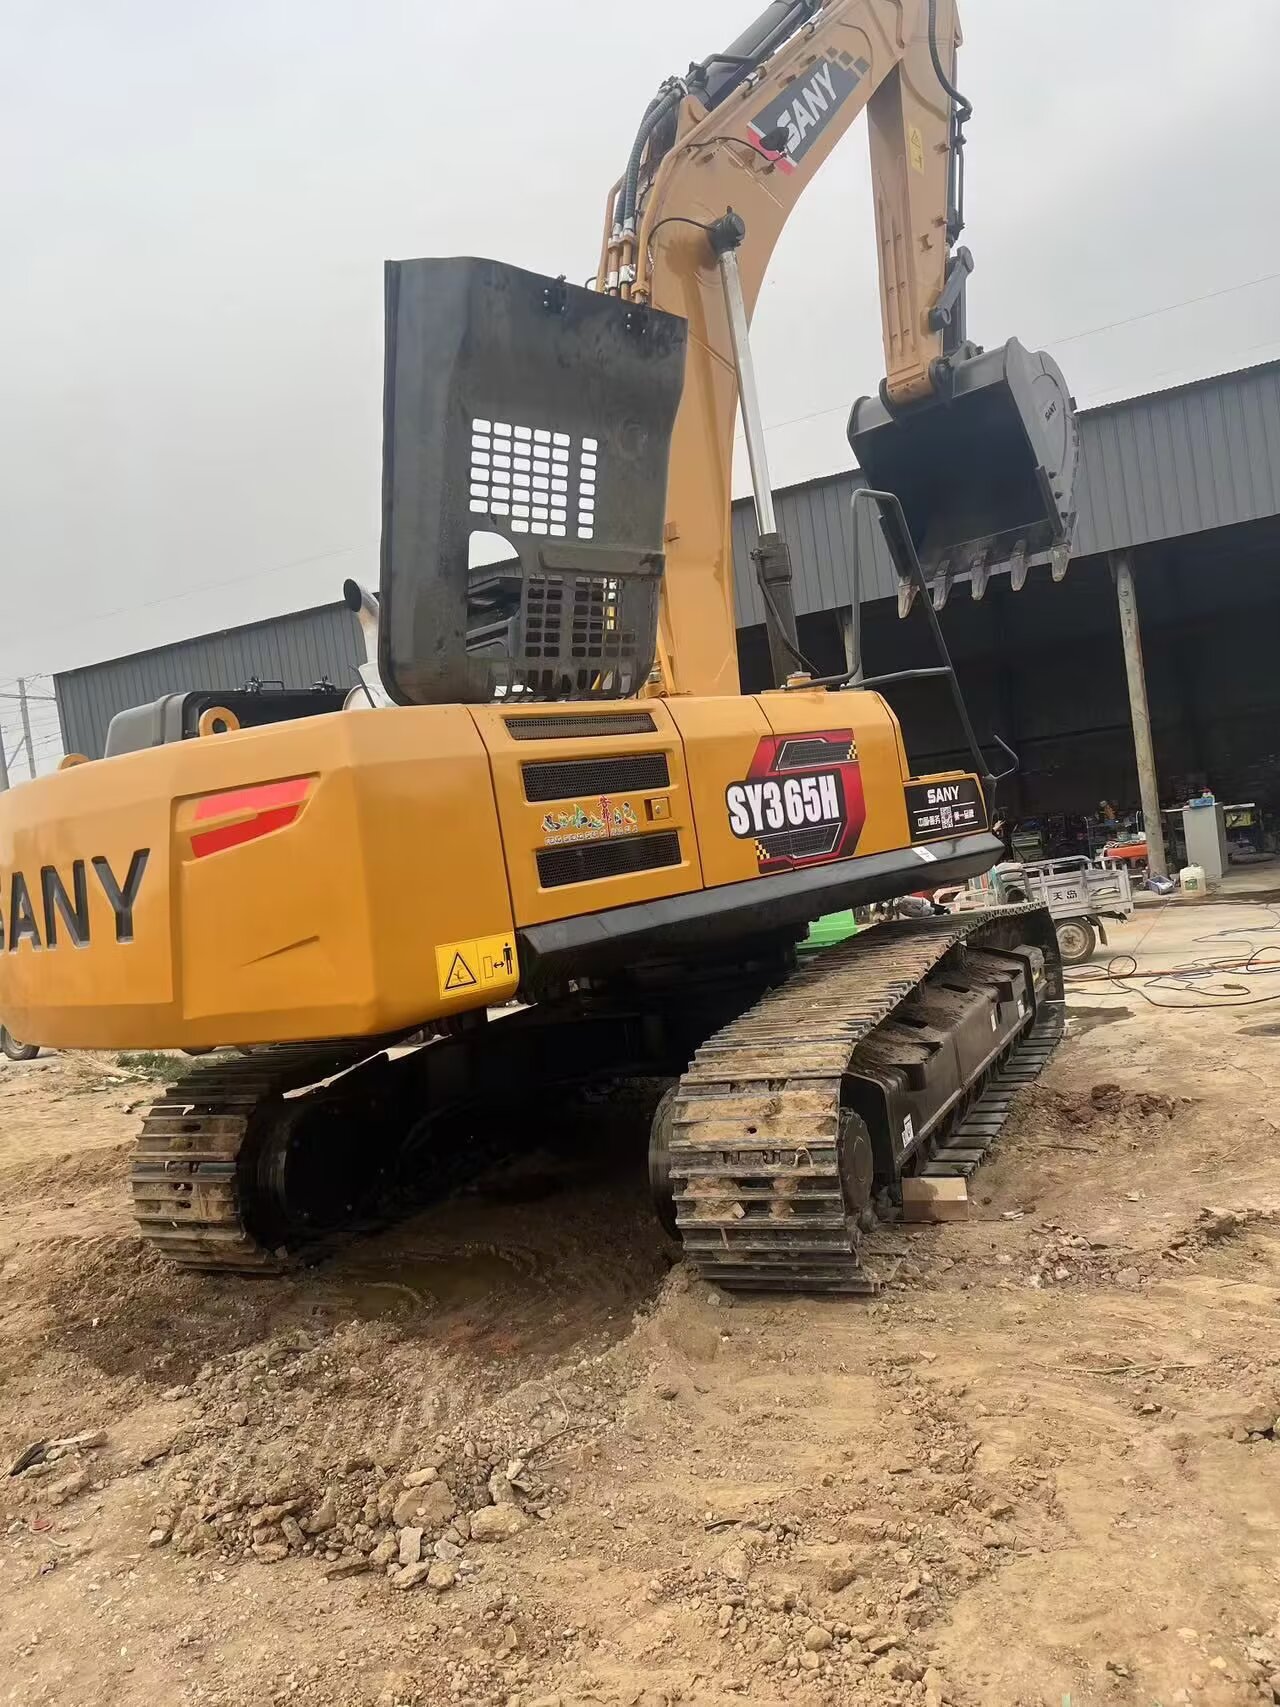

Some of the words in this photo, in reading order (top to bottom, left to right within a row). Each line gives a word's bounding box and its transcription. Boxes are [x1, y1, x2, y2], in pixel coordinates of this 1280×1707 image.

[777, 62, 837, 153] SANY
[727, 774, 840, 835] SY365H
[927, 785, 960, 804] SANY
[0, 847, 150, 955] ANY
